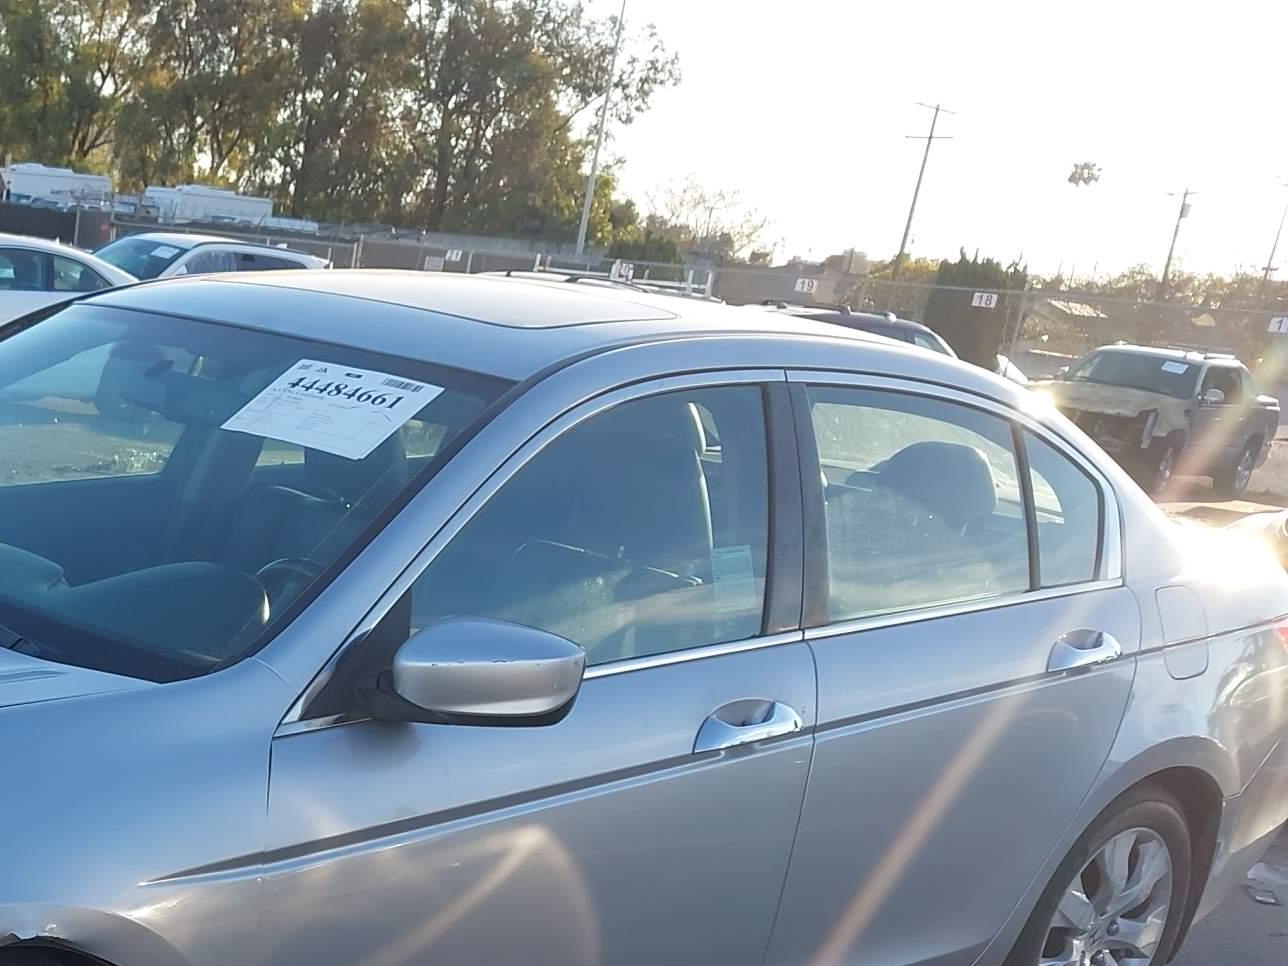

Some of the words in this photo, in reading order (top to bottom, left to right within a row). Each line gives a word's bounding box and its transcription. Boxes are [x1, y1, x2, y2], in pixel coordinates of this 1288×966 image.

[801, 279, 815, 291] 19
[977, 294, 993, 306] 18
[288, 376, 404, 409] 44484661
